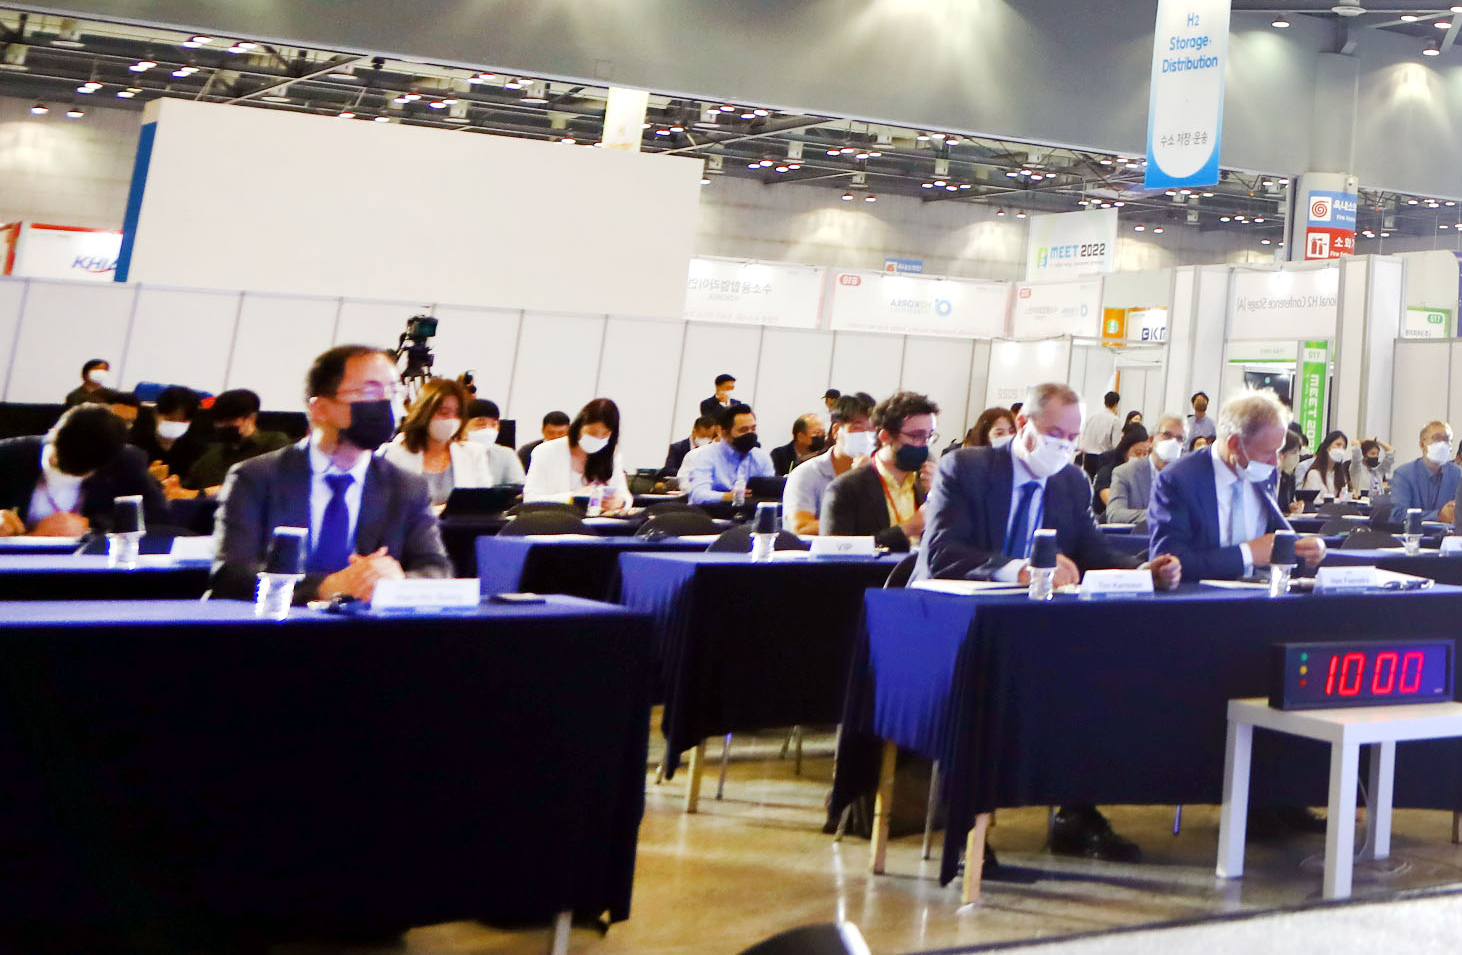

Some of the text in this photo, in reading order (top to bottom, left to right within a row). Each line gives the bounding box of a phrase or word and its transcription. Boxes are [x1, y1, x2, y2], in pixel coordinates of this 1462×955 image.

[1187, 13, 1200, 27] H2
[1162, 54, 1218, 74] Distribution
[1160, 134, 1174, 147] 수소
[1050, 243, 1106, 258] MEET 2022
